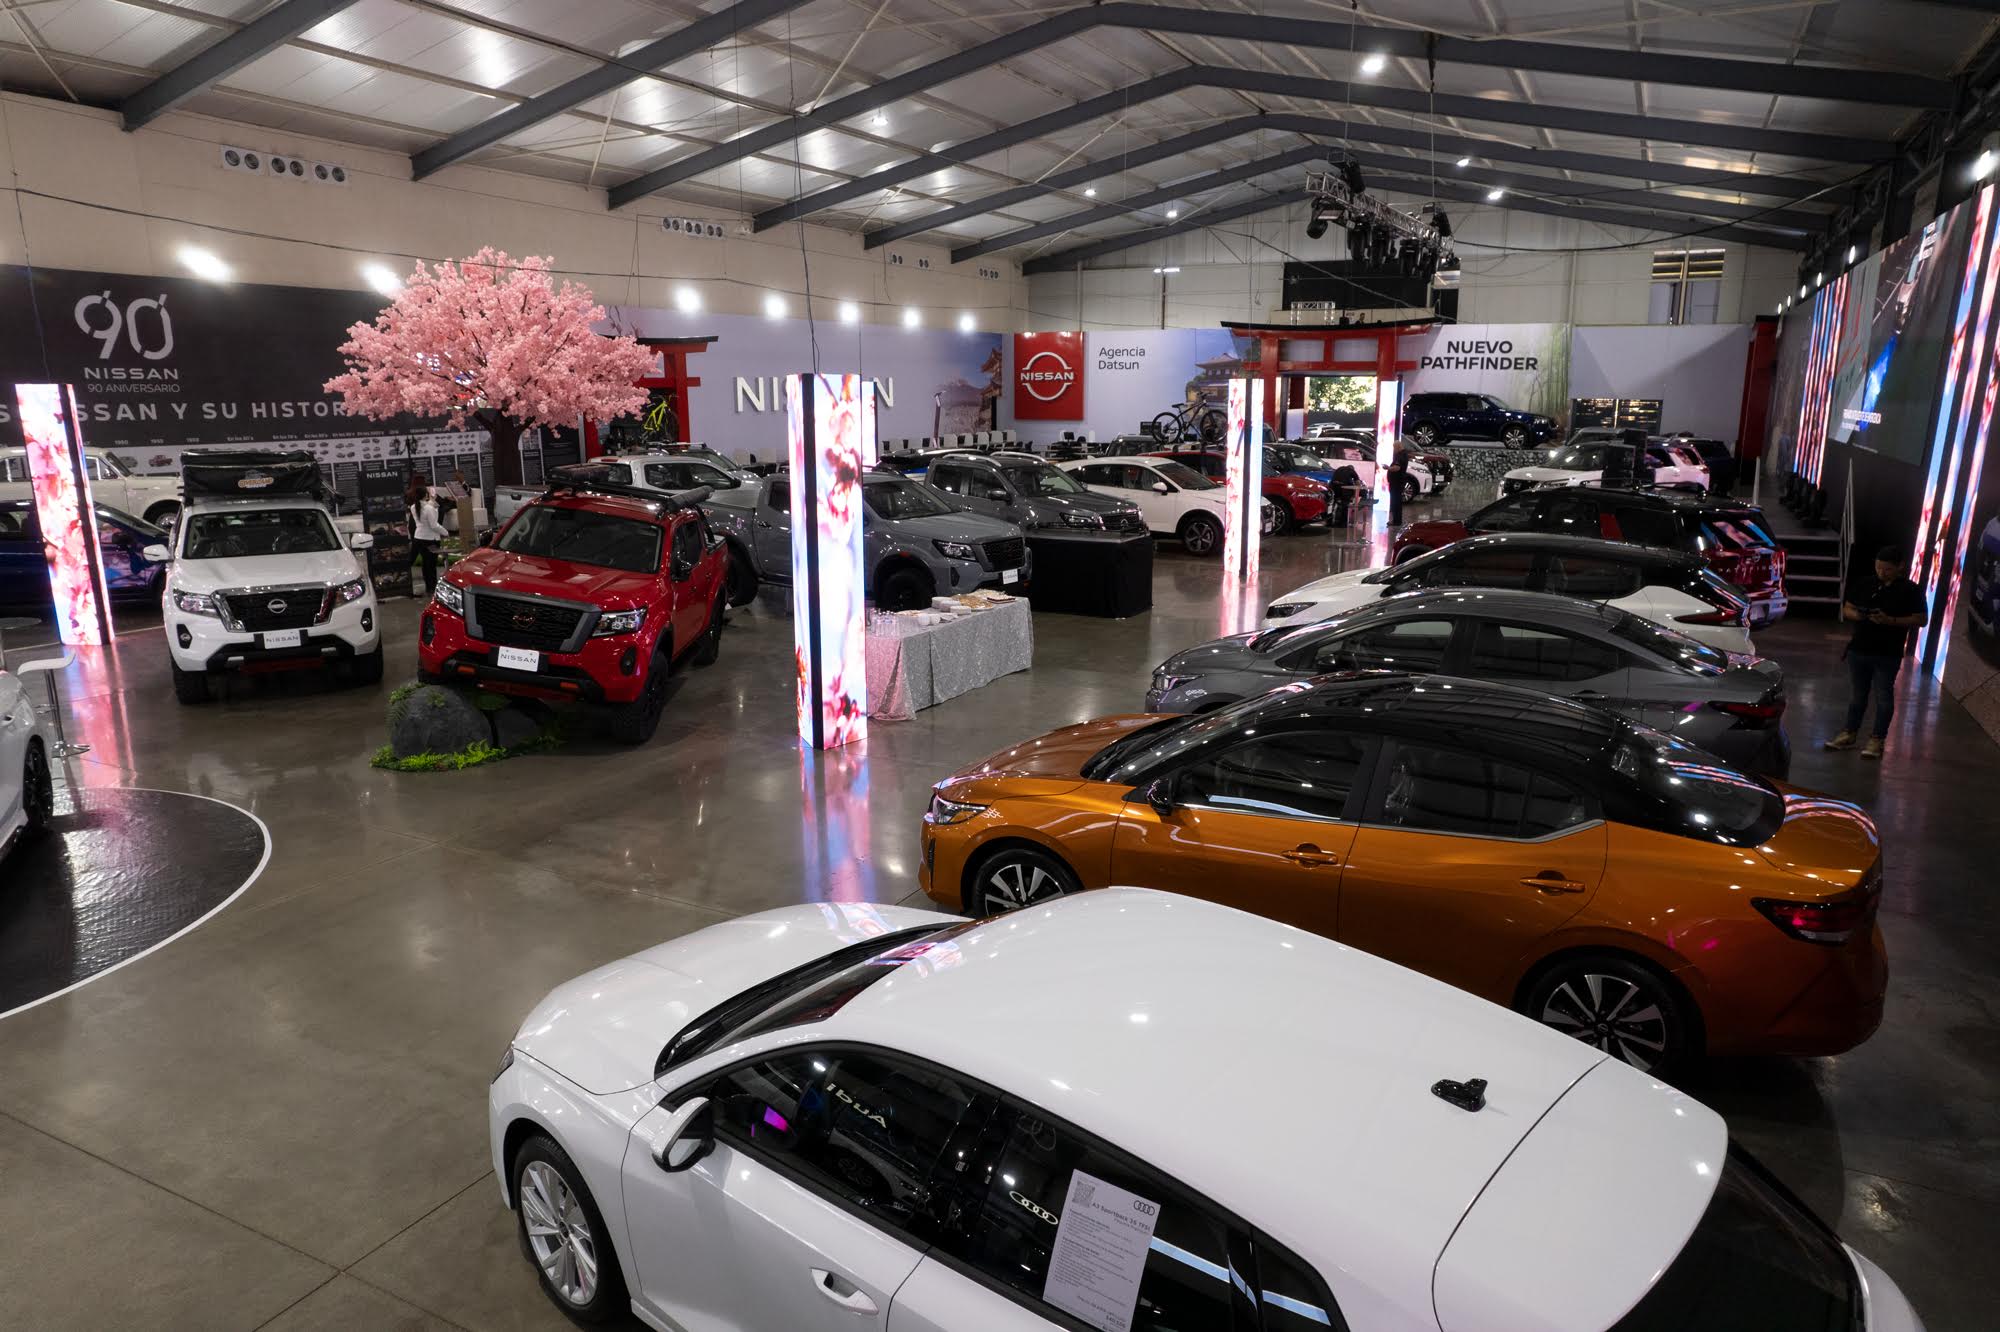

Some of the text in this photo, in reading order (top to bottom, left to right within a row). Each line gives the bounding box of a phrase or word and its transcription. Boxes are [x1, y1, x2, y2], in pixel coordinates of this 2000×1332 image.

[1099, 346, 1146, 359] Agencia
[1447, 341, 1513, 354] NUEVO
[1098, 360, 1140, 370] Datsun
[1420, 356, 1538, 371] PATHFINDER
[84, 367, 179, 380] NISSAN
[1020, 371, 1074, 381] NISSAN
[87, 384, 180, 393] 90 ANIVERSARIO
[736, 376, 894, 412] NIN
[171, 403, 188, 420] Y
[203, 402, 238, 420] SU
[252, 401, 346, 419] HISTOR
[366, 471, 398, 479] NISSAN
[500, 653, 537, 664] NISSAN
